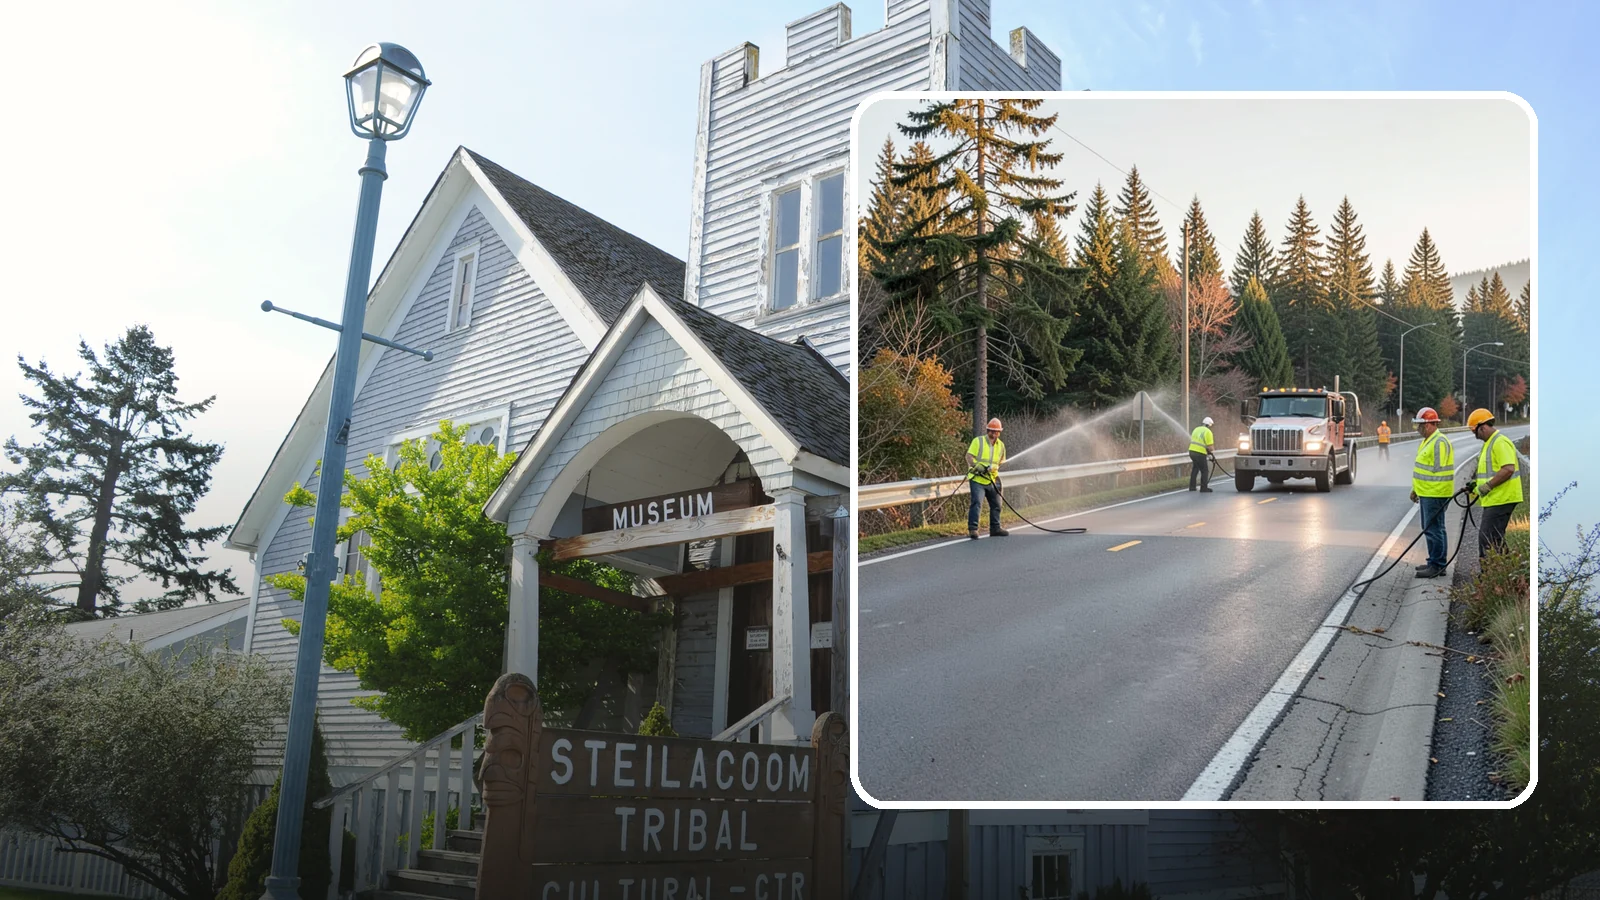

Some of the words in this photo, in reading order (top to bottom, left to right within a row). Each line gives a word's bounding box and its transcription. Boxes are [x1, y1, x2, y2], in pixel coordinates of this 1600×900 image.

[613, 491, 714, 531] MUSEUM
[550, 738, 810, 792] STEILACOOM
[614, 806, 758, 852] TRIBAL
